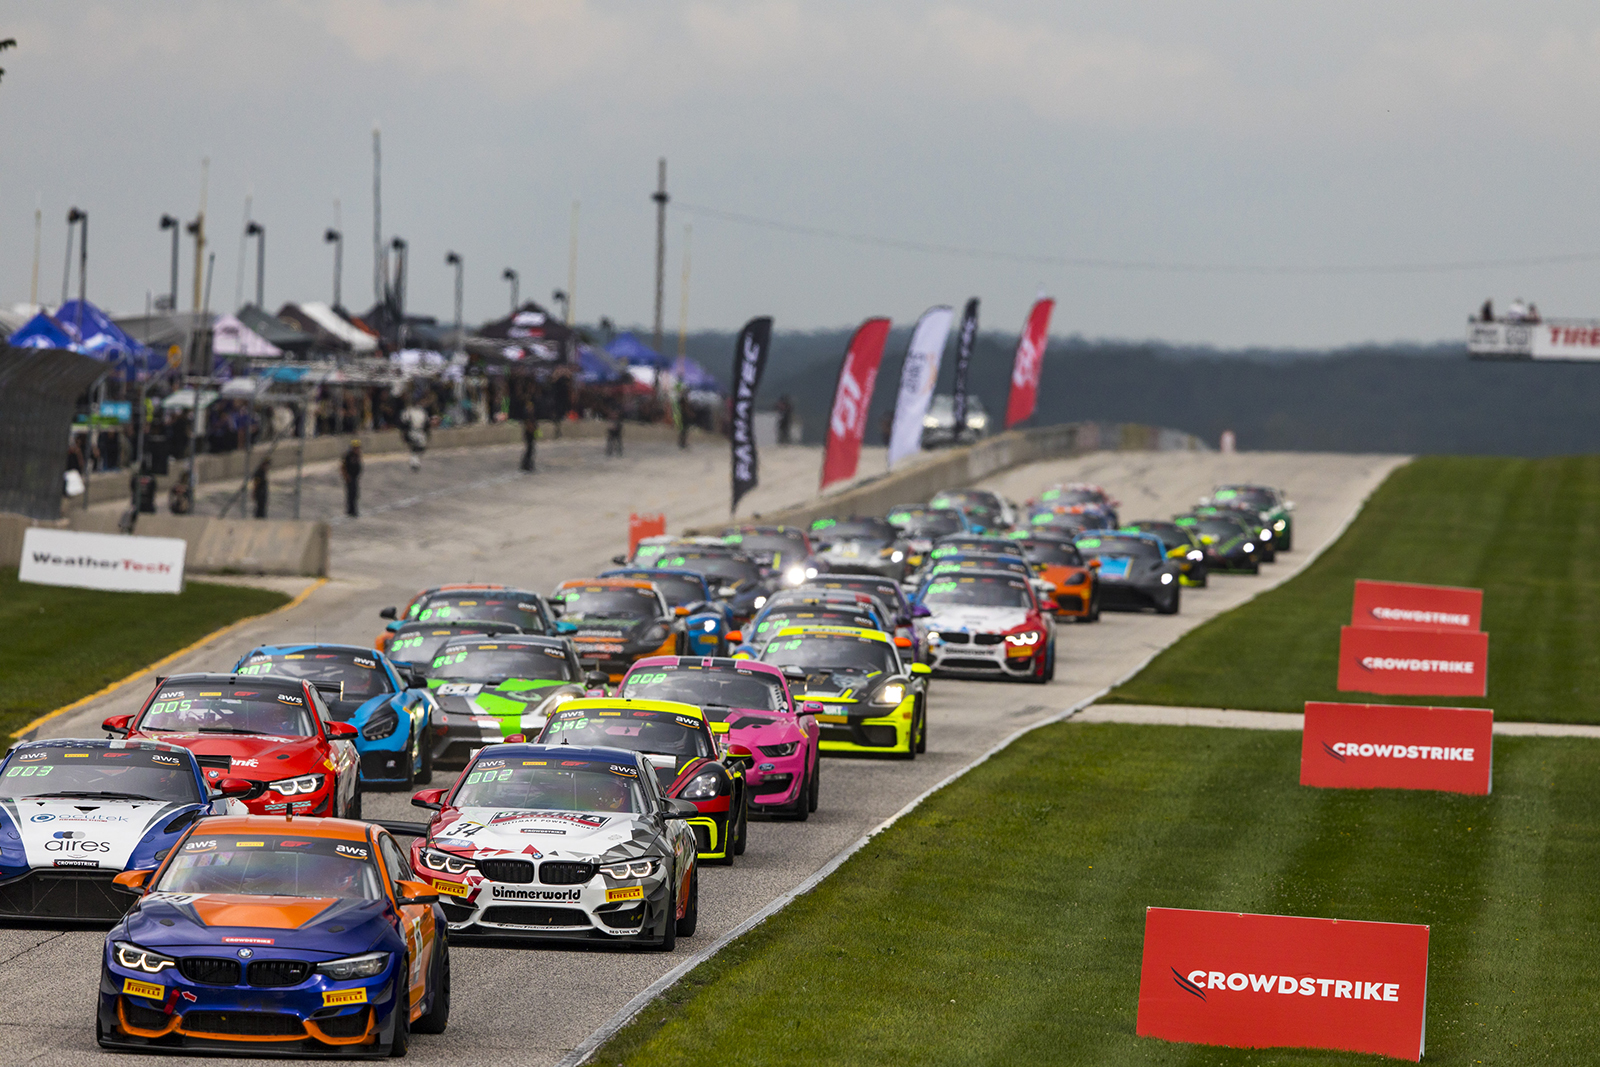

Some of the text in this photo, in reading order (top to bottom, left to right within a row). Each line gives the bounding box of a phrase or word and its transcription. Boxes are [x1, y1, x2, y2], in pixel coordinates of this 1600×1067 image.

[734, 332, 760, 482] FANATEC
[33, 551, 172, 574] WeatherTech
[1372, 607, 1470, 626] CROWDSTRIKE
[354, 657, 376, 667] aws
[1362, 657, 1474, 673] CROWDSTRIKE
[160, 691, 184, 699] aws
[278, 694, 302, 704] aws
[151, 700, 192, 715] 005
[560, 711, 584, 719] aws
[676, 716, 700, 727] aws
[19, 752, 48, 760] aws
[1332, 742, 1474, 761] CROWDSTRIKE
[152, 754, 180, 764] aws
[477, 760, 506, 768] aws
[6, 766, 54, 777] 003
[467, 769, 514, 785] 002
[609, 765, 637, 775] aws
[446, 823, 484, 838] 34
[44, 839, 111, 853] aires
[185, 840, 217, 850] aws
[336, 844, 367, 857] aws
[435, 881, 466, 895] PIRELLI
[492, 886, 581, 900] bimmerworld
[608, 888, 641, 899] PIRELLI
[126, 982, 162, 997] PIRELLI
[1187, 970, 1400, 1002] CROWDSTRIKE
[325, 989, 364, 1004] PIRELLI
